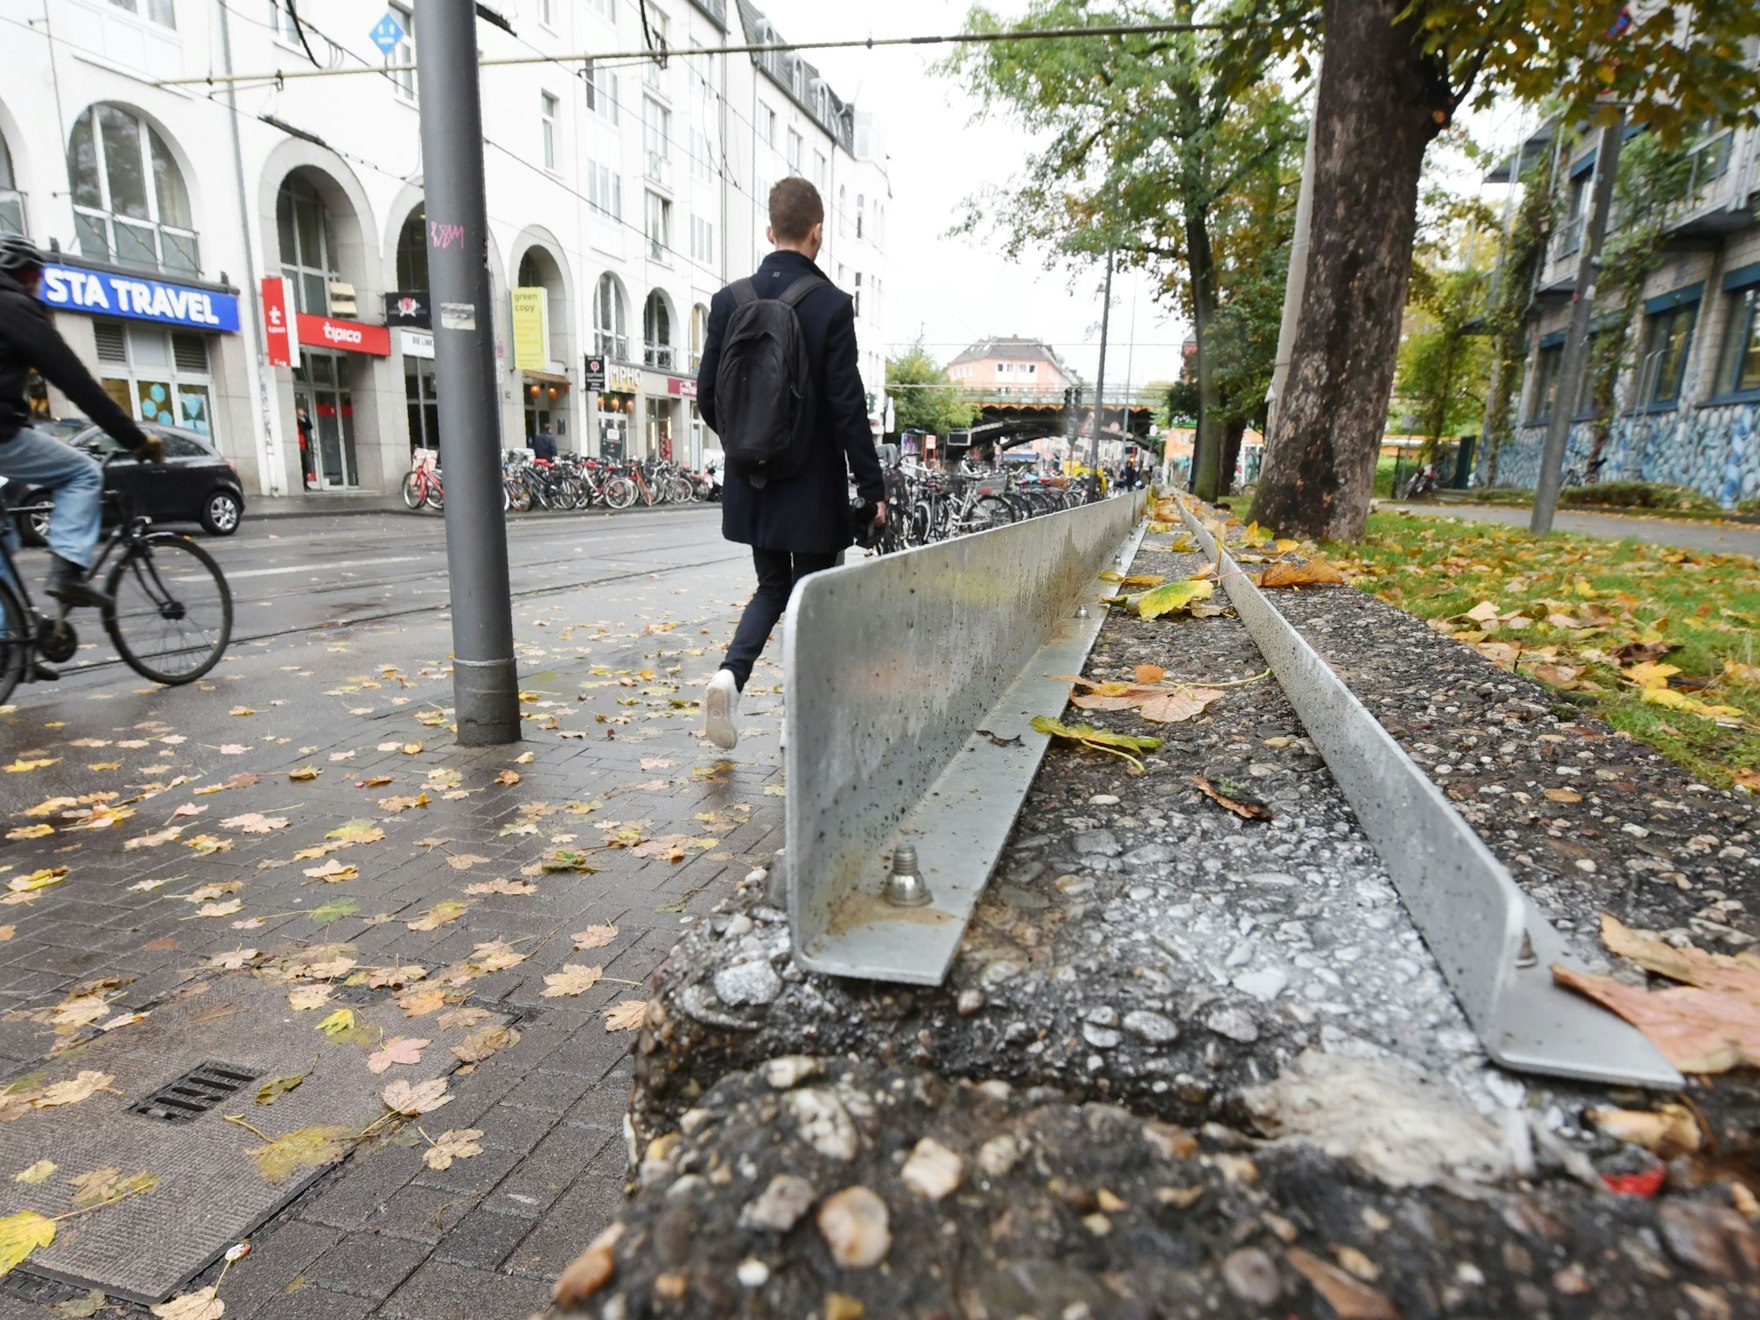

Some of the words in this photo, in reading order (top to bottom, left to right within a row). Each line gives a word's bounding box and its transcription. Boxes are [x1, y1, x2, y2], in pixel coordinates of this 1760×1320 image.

[44, 267, 109, 310] STA
[110, 278, 220, 325] TRAVEL
[514, 293, 538, 302] green
[514, 304, 536, 312] copy
[323, 321, 362, 344] tipico
